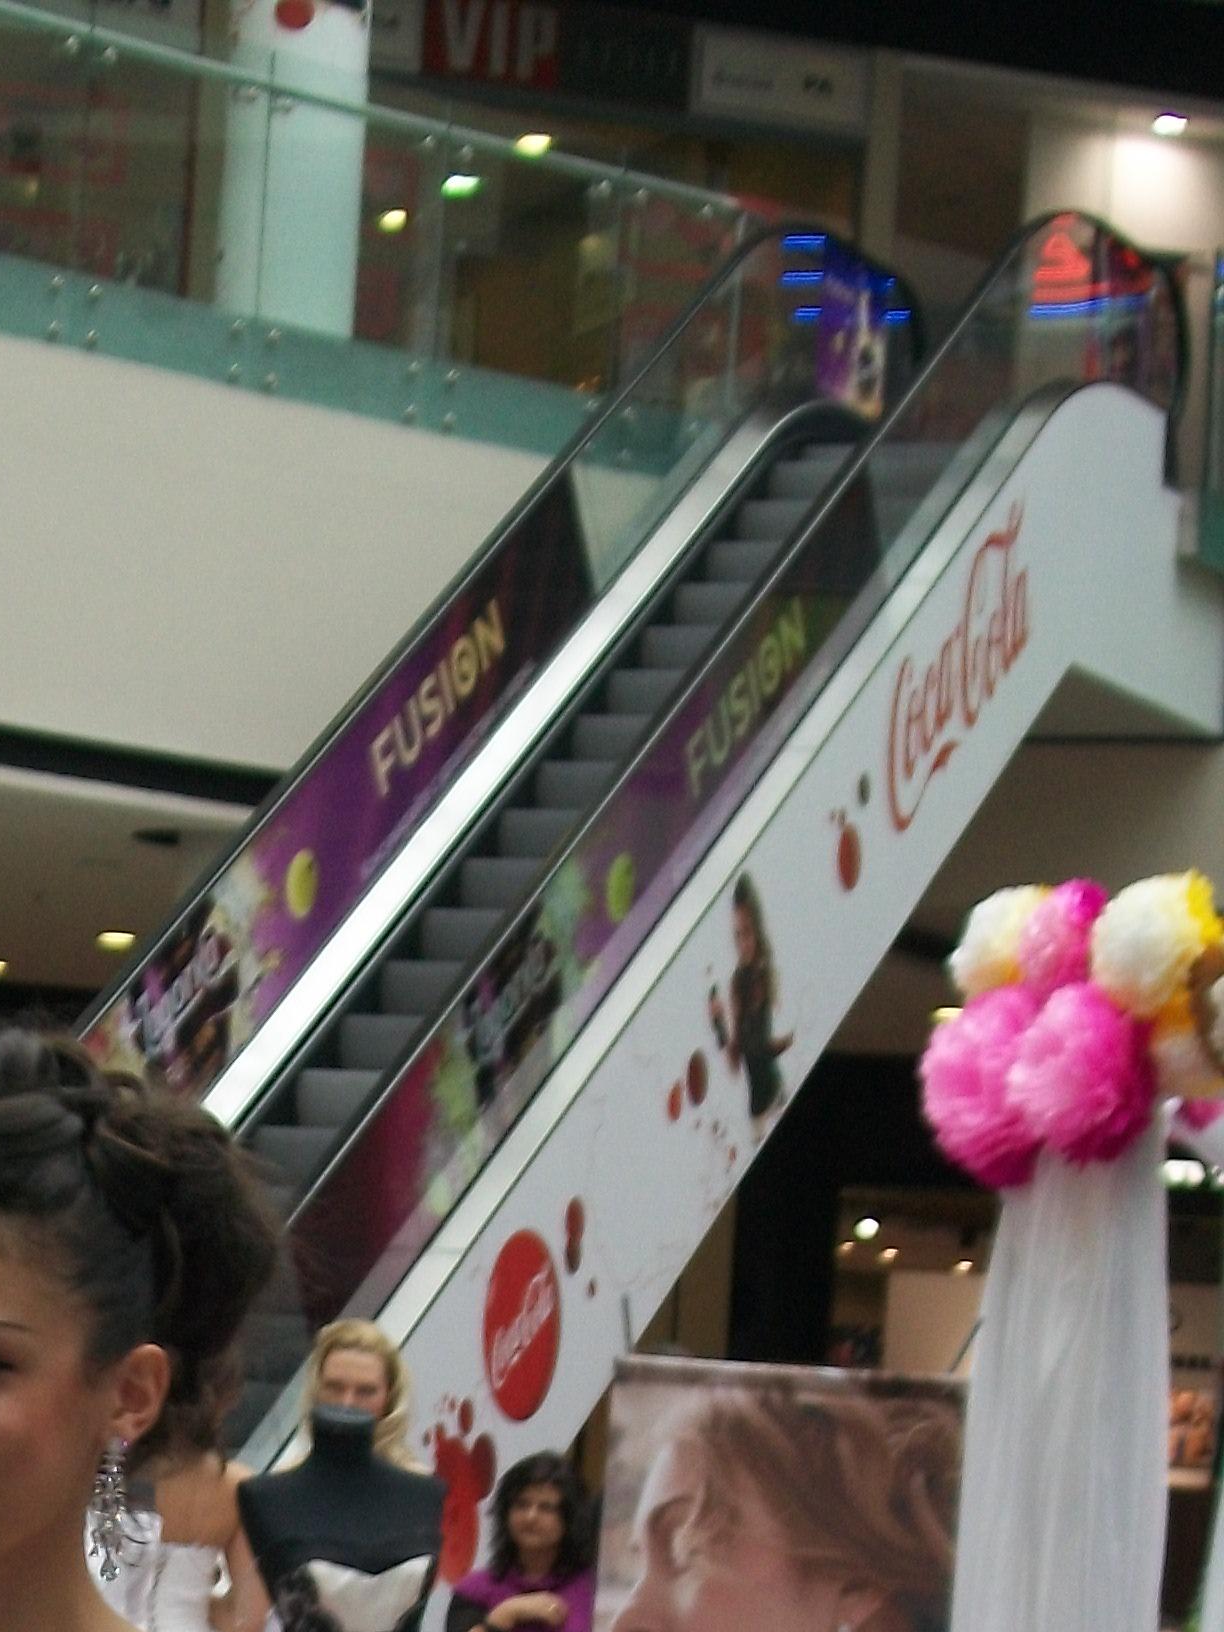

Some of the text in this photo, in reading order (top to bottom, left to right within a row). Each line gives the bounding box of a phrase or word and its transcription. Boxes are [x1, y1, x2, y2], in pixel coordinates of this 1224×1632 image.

[441, 0, 559, 80] VIP
[371, 597, 505, 795] FUSION
[686, 595, 806, 797] FUSION
